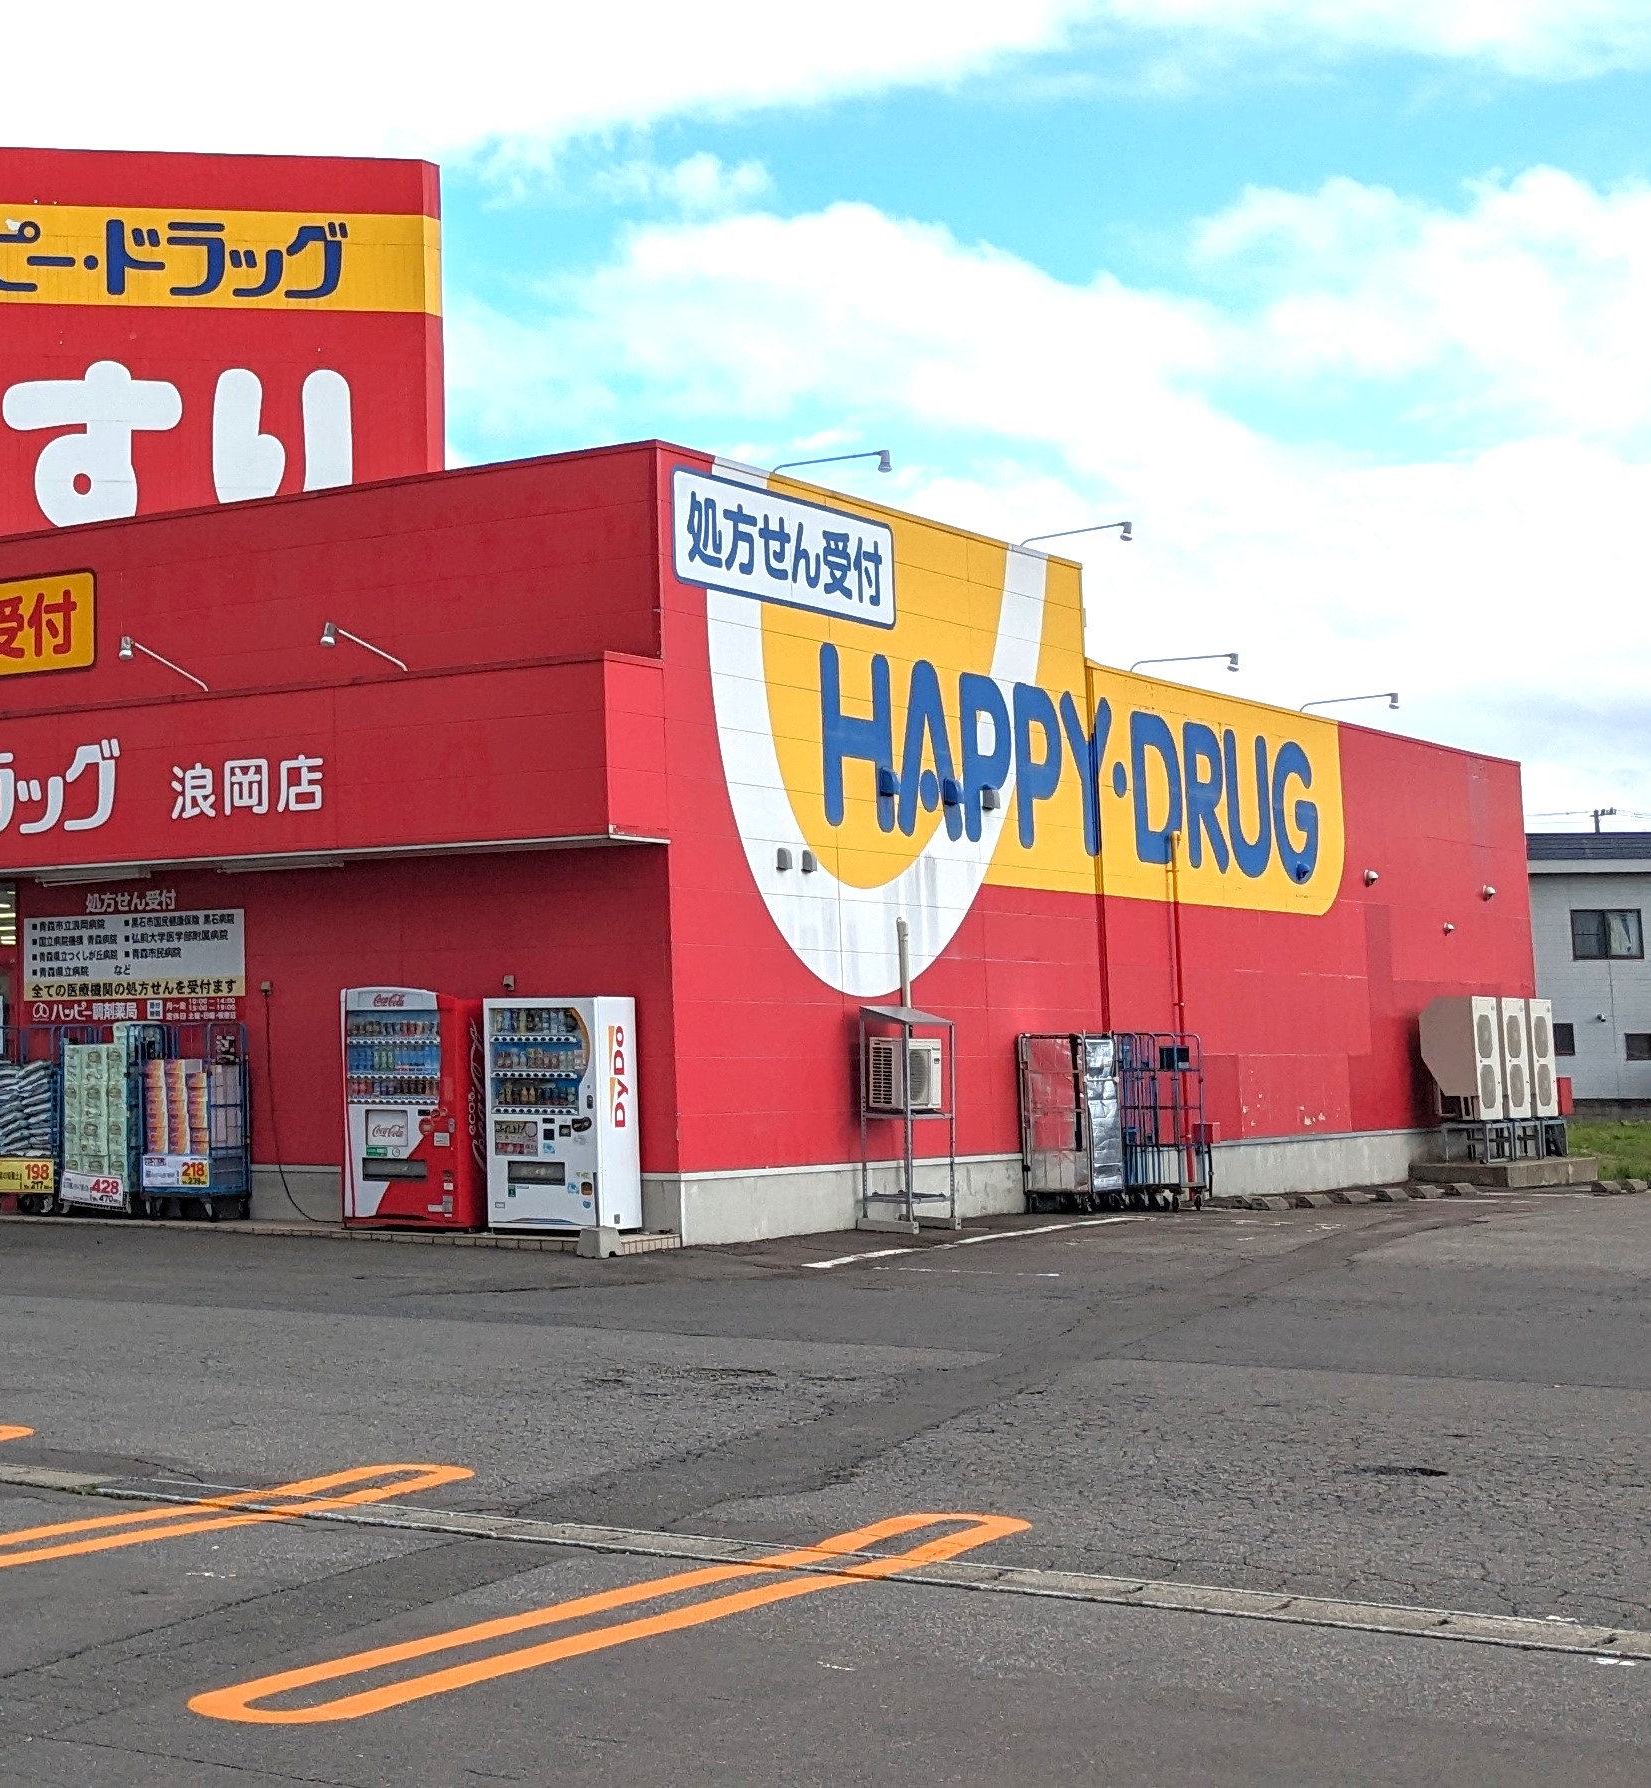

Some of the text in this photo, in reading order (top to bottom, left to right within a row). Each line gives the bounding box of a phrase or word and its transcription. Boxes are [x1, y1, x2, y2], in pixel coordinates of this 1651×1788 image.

[687, 490, 883, 606] 処方せん受付
[170, 754, 324, 820] 浪岡店
[85, 889, 177, 913] 処方せん受付
[114, 964, 131, 975] など
[31, 979, 237, 998] 全ての医療機関の処方せんを受付ます
[51, 1001, 138, 1021] ハッピー調剤薬局
[25, 1163, 50, 1180] 198
[181, 1162, 205, 1177] 218
[93, 1179, 119, 1195] 428
